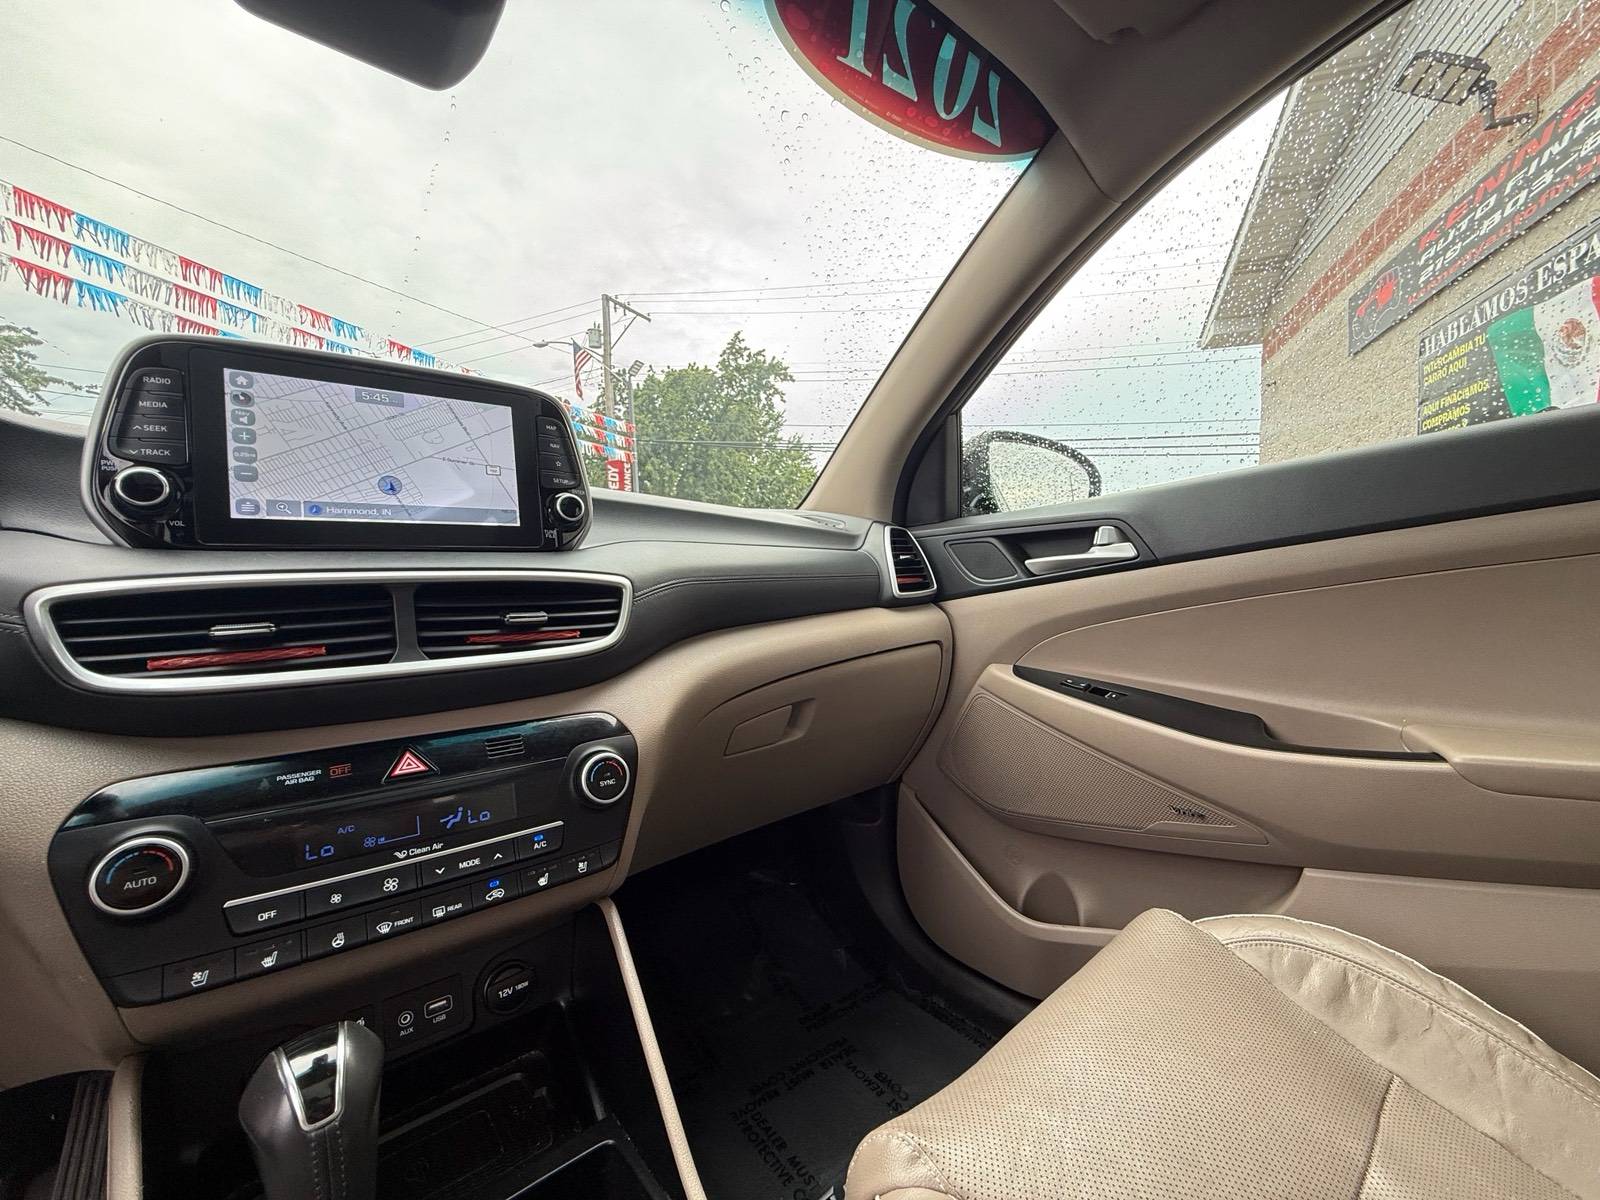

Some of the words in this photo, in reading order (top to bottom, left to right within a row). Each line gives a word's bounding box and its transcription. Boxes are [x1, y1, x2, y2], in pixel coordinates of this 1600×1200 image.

[1419, 194, 1497, 266] AUTO
[1423, 277, 1529, 357] HABLAMOS
[1424, 341, 1473, 374] INTERCAMBIA
[1474, 333, 1486, 348] TU
[142, 376, 171, 385] RADIO
[1424, 366, 1447, 386] CARRO
[361, 391, 389, 402] 5:45
[138, 400, 168, 409] MEDIA
[1422, 404, 1471, 430] COMPRAMOS
[143, 424, 168, 432] SEEK
[140, 448, 171, 456] TRACK
[553, 477, 569, 485] SETUP
[608, 464, 620, 489] EDY
[326, 507, 380, 517] Hammond,
[276, 769, 321, 781] PASSENGER
[329, 766, 351, 776] OFF
[284, 778, 297, 786] AIR
[298, 776, 315, 784] BAG
[600, 778, 616, 787] SYNC
[337, 824, 355, 834] A/C
[409, 846, 430, 856] Clean
[432, 842, 443, 851] Air
[533, 841, 547, 850] A/C
[459, 857, 481, 869] MODE
[123, 876, 157, 890] AUTO
[447, 903, 462, 911] REAR
[257, 909, 277, 922] OFF
[394, 916, 414, 927] FRONT
[498, 986, 513, 999] 12V
[432, 1013, 446, 1023] USB
[400, 1027, 414, 1037] AUX
